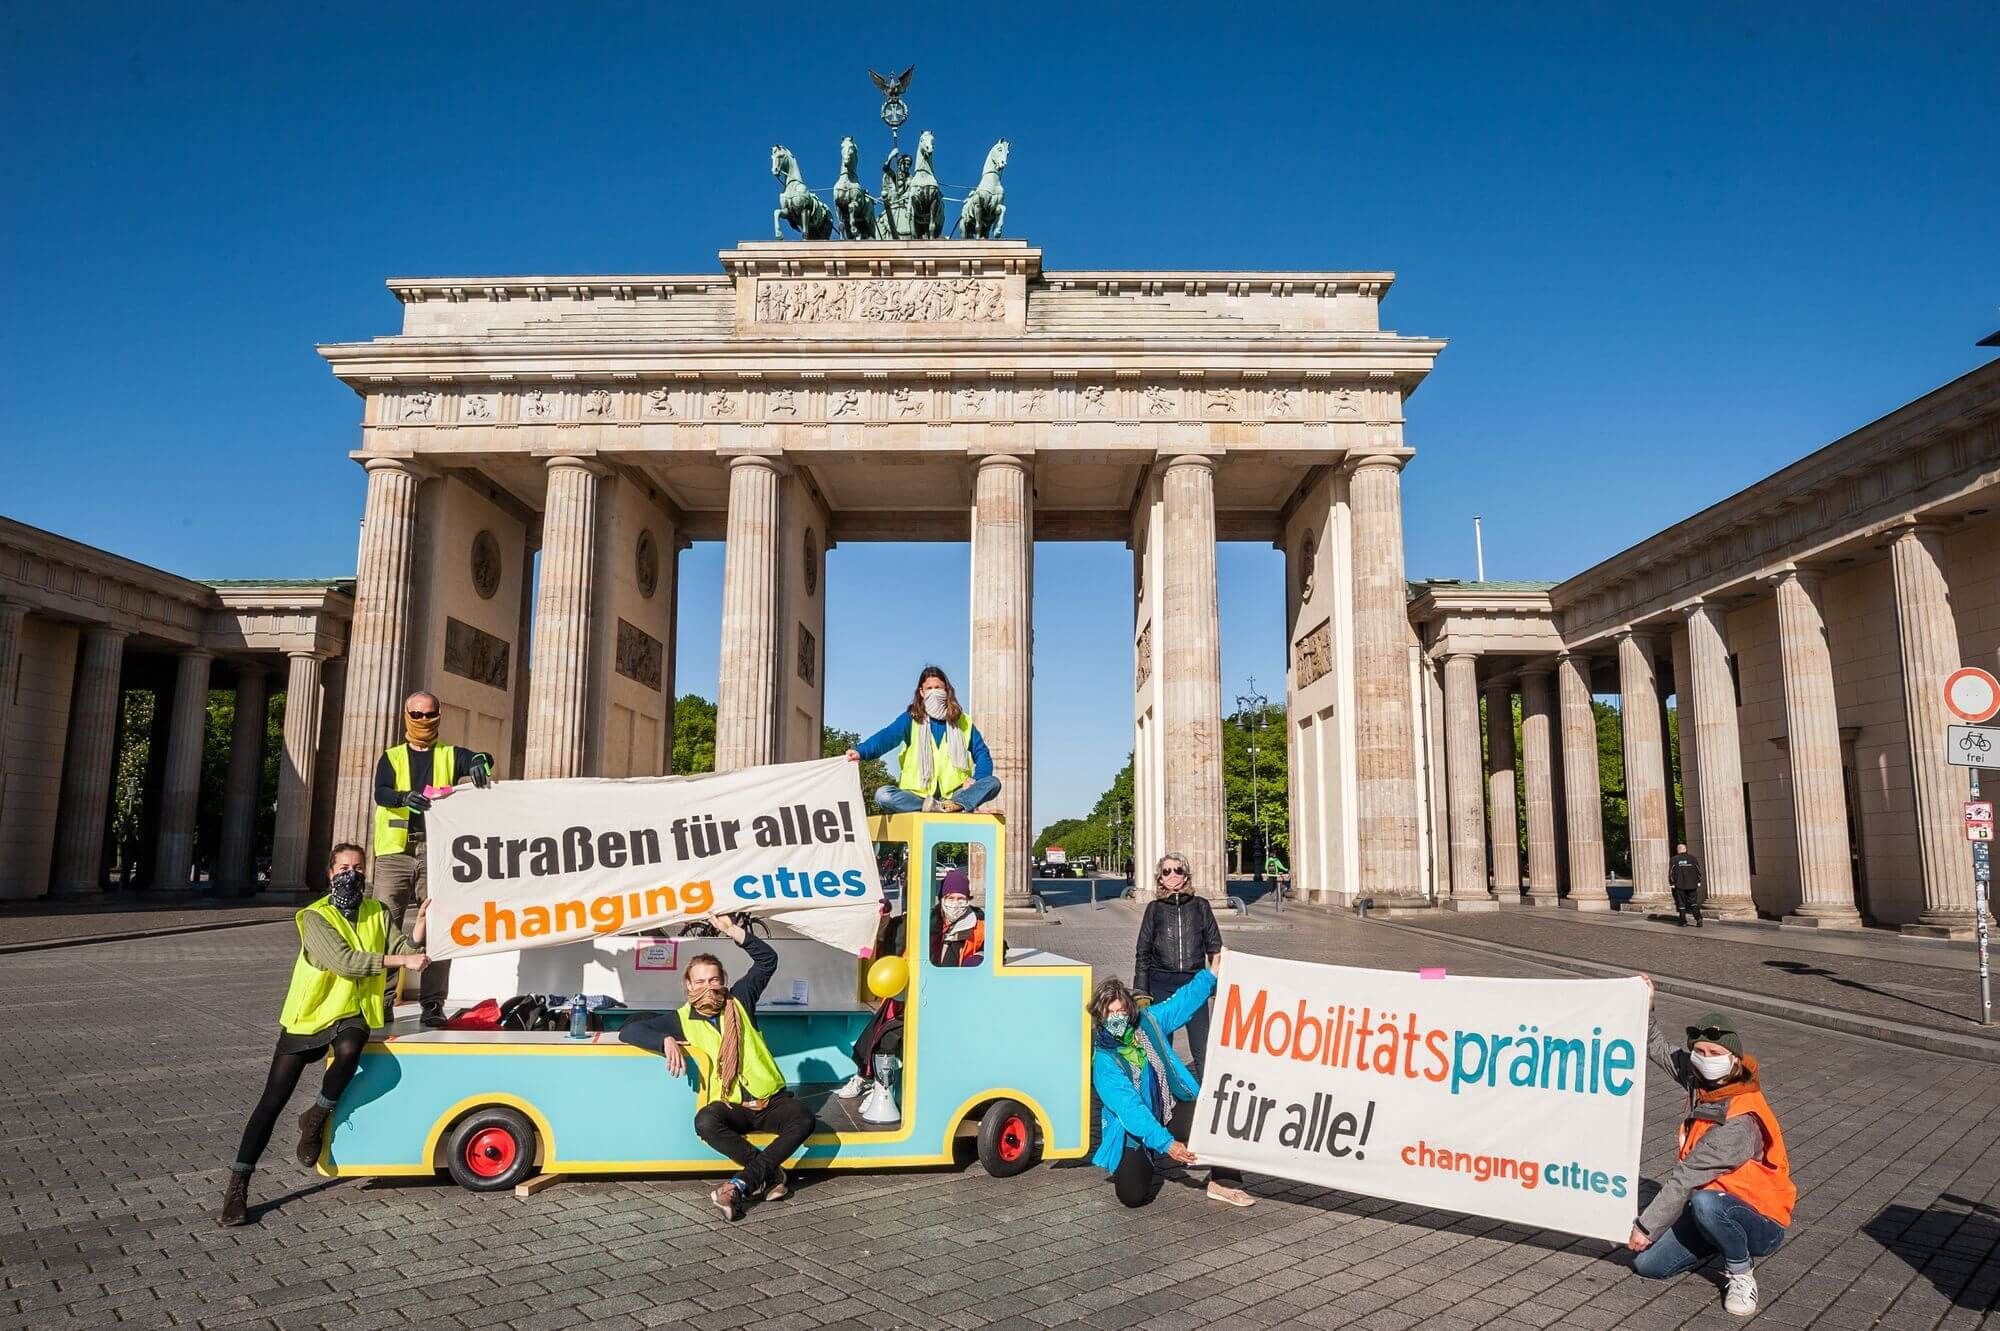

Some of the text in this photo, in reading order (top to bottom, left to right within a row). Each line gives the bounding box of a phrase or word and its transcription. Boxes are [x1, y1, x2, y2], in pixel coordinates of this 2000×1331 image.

[1966, 753, 1985, 763] frei
[451, 801, 856, 883] Straßen für alle!
[450, 866, 866, 946] changing cities
[1219, 984, 1636, 1096] Mobilitätsprämie
[1209, 1073, 1376, 1161] für alle!
[1400, 1140, 1628, 1198] changing cities
